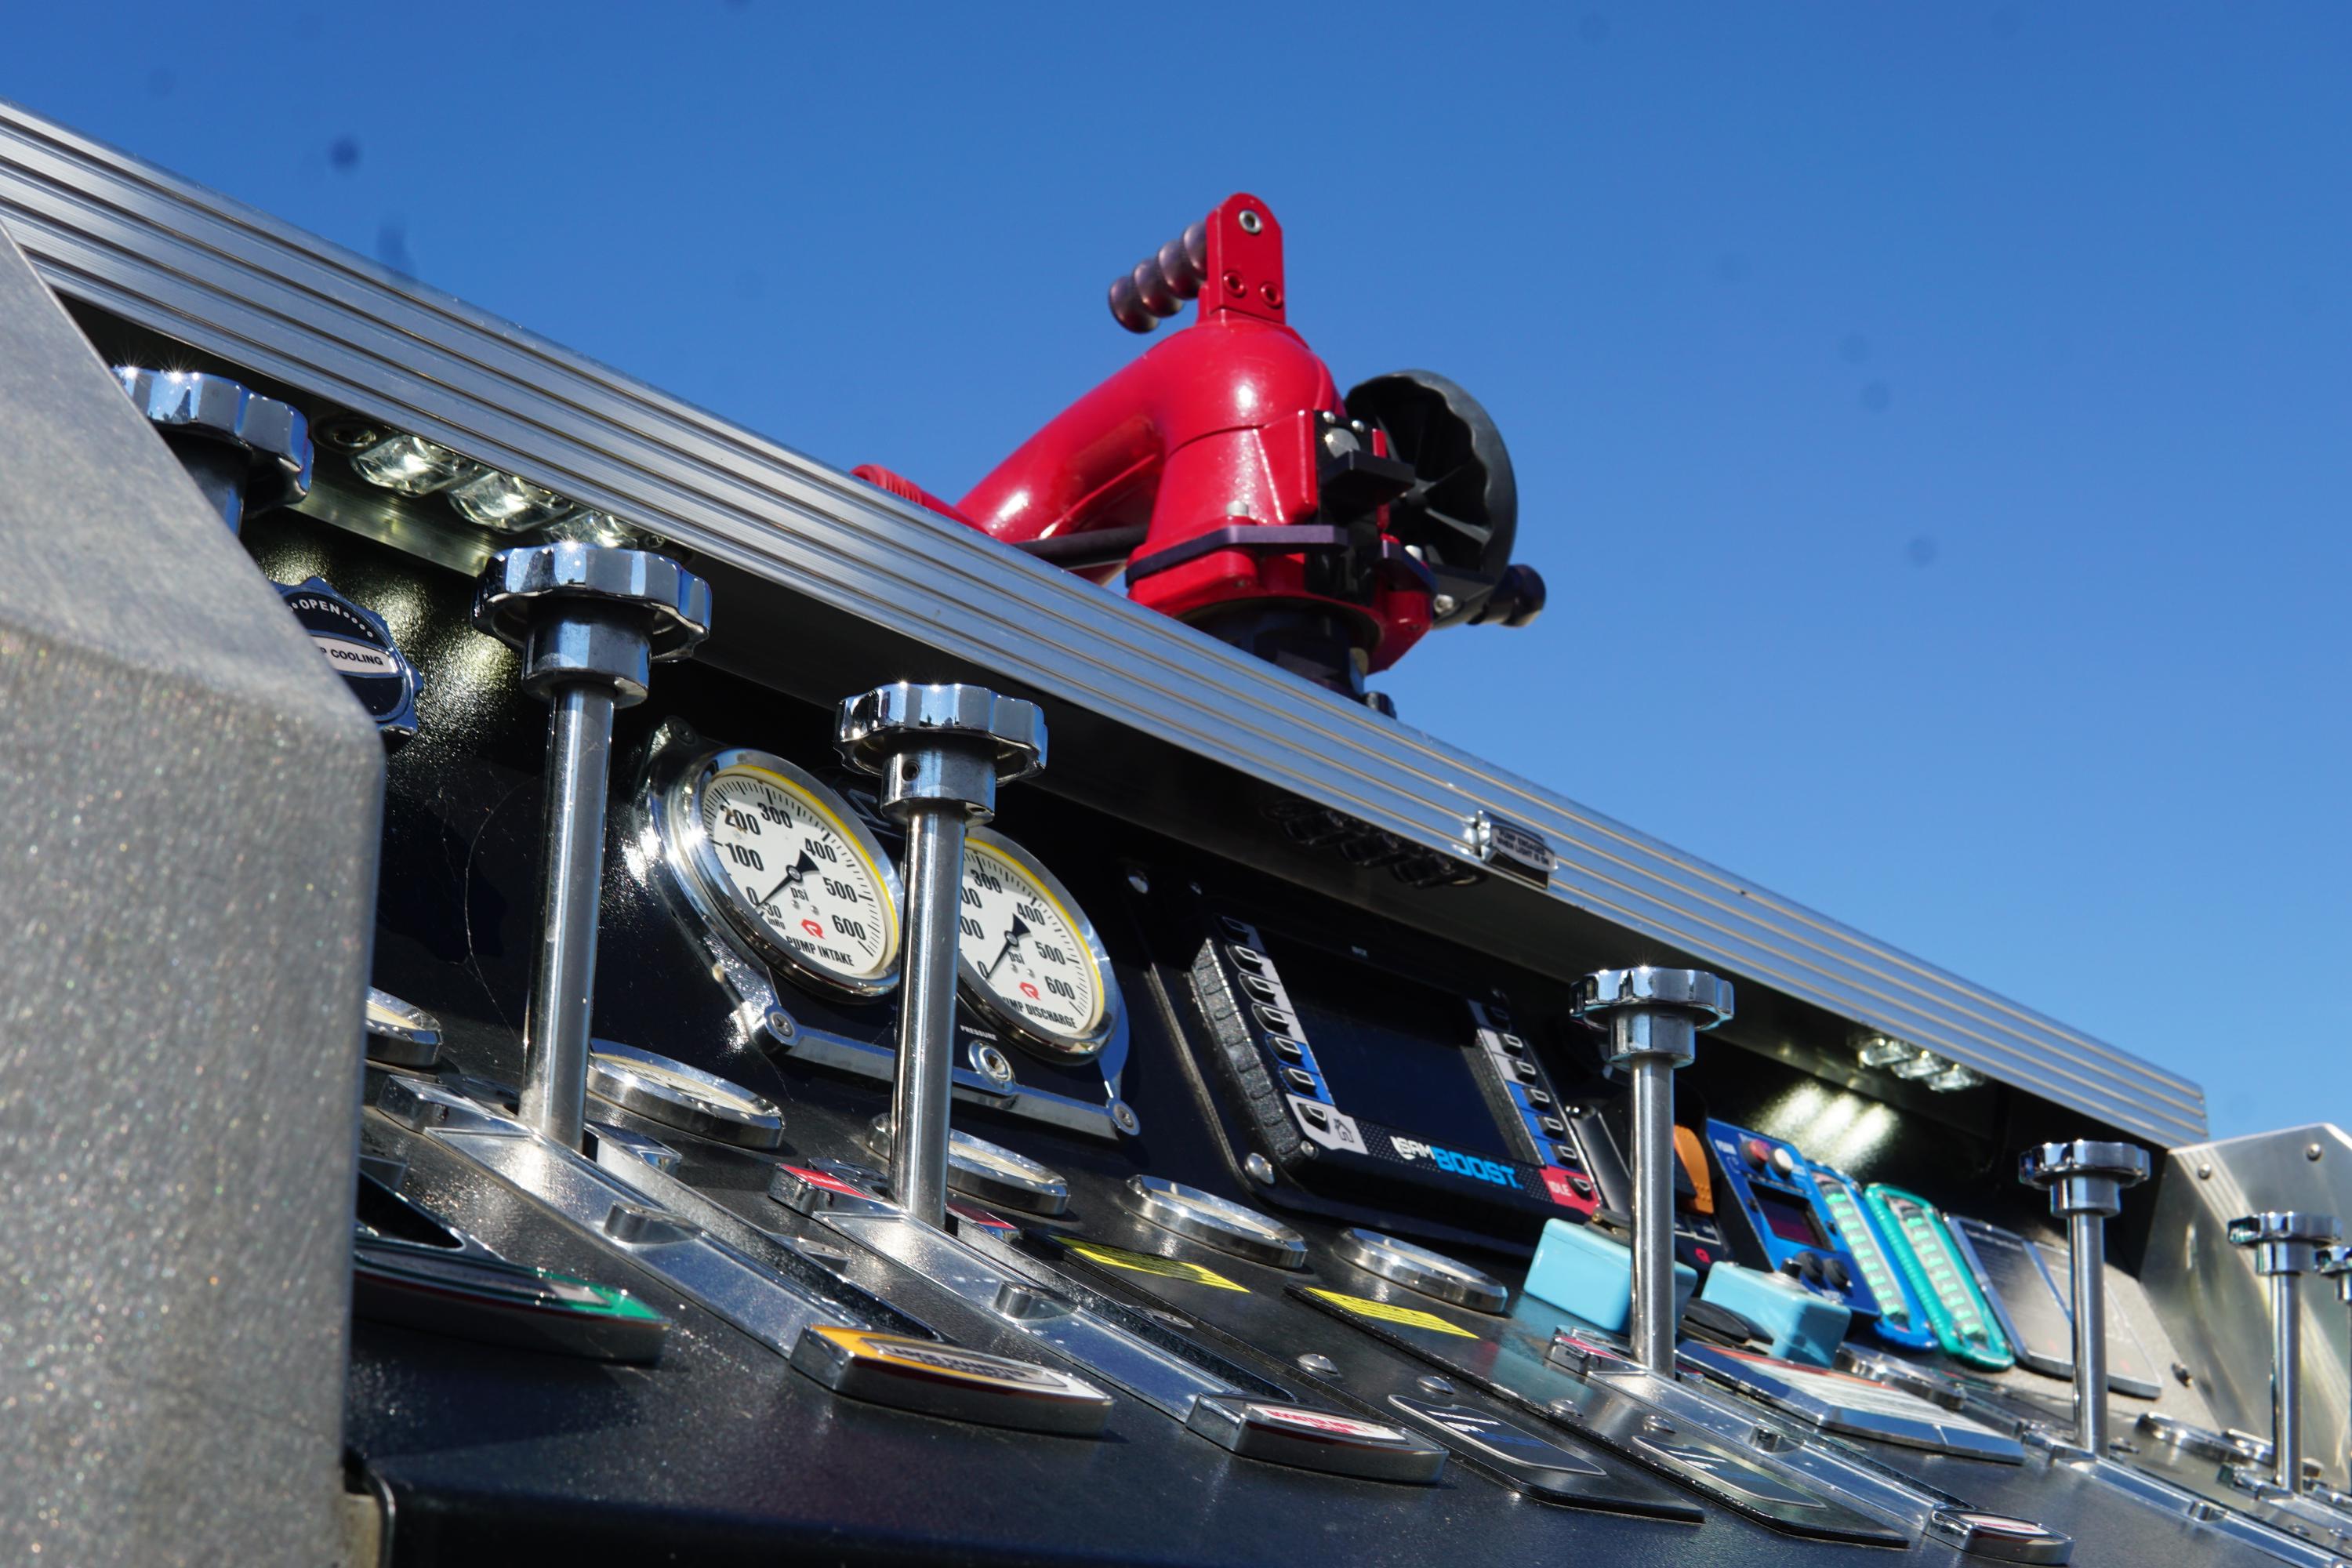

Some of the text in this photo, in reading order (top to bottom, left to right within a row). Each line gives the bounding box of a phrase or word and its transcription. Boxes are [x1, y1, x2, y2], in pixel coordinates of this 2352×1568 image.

[299, 599, 340, 615] OPEN
[330, 648, 383, 666] COOLING
[720, 804, 761, 836] 200
[757, 802, 793, 829] 300
[724, 842, 764, 871] 100
[804, 837, 837, 863] 400
[822, 877, 858, 903] 500
[971, 869, 1003, 893] 300
[746, 886, 760, 907] 0
[790, 887, 809, 902] psi
[961, 886, 983, 909] 00
[1017, 902, 1046, 925] 400
[831, 914, 866, 941] 600
[960, 916, 985, 940] 00
[786, 935, 855, 967] PUMP INTAKE
[1008, 951, 1025, 965] psi
[1034, 941, 1066, 965] 500
[977, 960, 989, 980] 0
[1044, 975, 1076, 1000] 600
[1025, 1003, 1077, 1029] DISCHARGE
